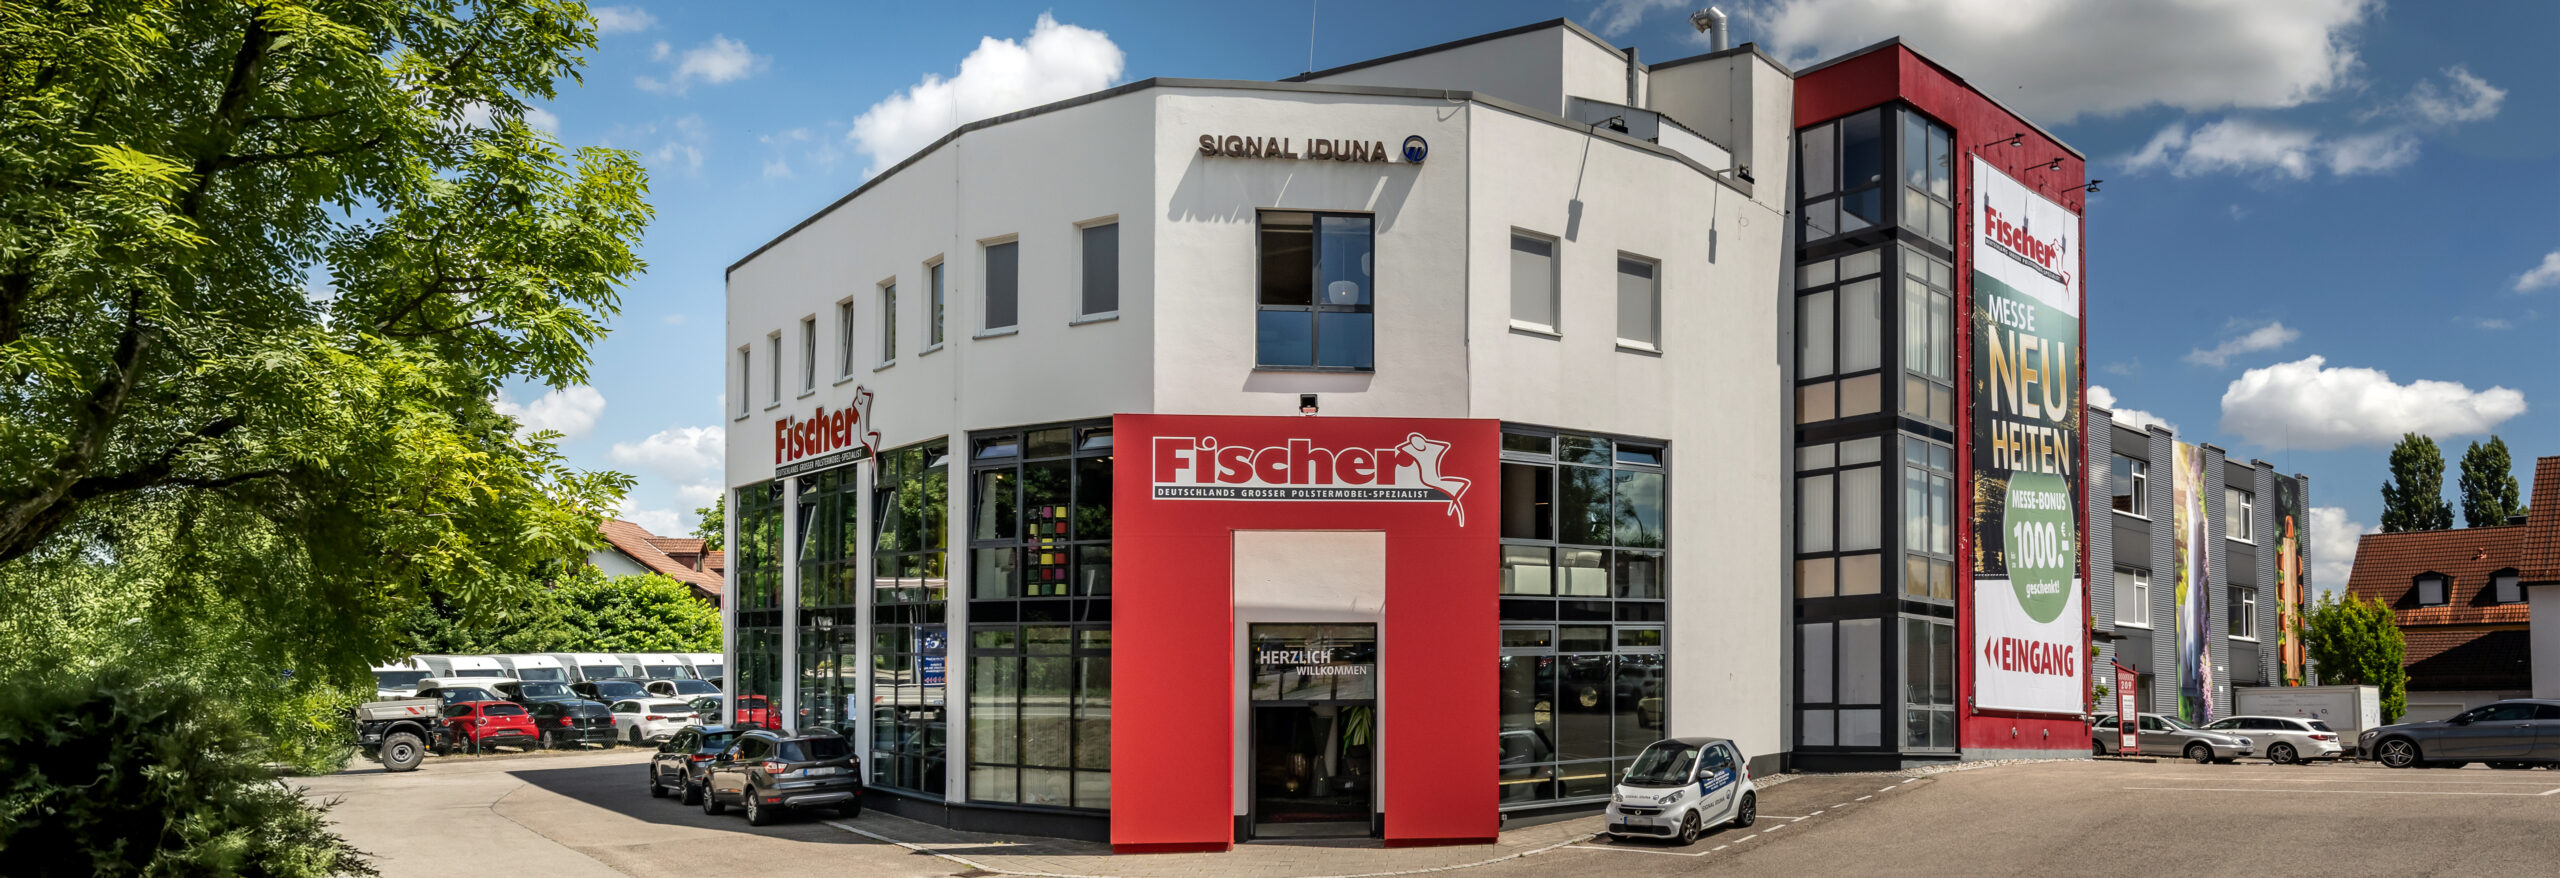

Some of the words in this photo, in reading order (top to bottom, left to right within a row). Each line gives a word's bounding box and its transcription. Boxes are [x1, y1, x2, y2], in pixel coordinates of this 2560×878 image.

[1199, 134, 1298, 160] SIGNAL
[1307, 138, 1389, 163] IDUNA
[1985, 205, 2057, 269] Fischer
[1988, 294, 2036, 332] MESSE
[1988, 325, 2068, 423] NEU
[776, 406, 859, 465] Fischer
[1992, 419, 2070, 476] HEITEN
[1153, 436, 1414, 486] Fischer
[1157, 488, 1236, 497] DEUTSCHLANDS
[1241, 489, 1286, 497] GROSSER
[1291, 488, 1429, 498] POLSTERMÖBEL-SPEZIALIST
[2012, 489, 2066, 512] MESSE-BONUS
[2026, 579, 2060, 598] geschenkt!
[1260, 650, 1331, 665] HERZLICH
[1296, 665, 1367, 676] WILLKOMMEN
[2002, 636, 2074, 678] EINGANG
